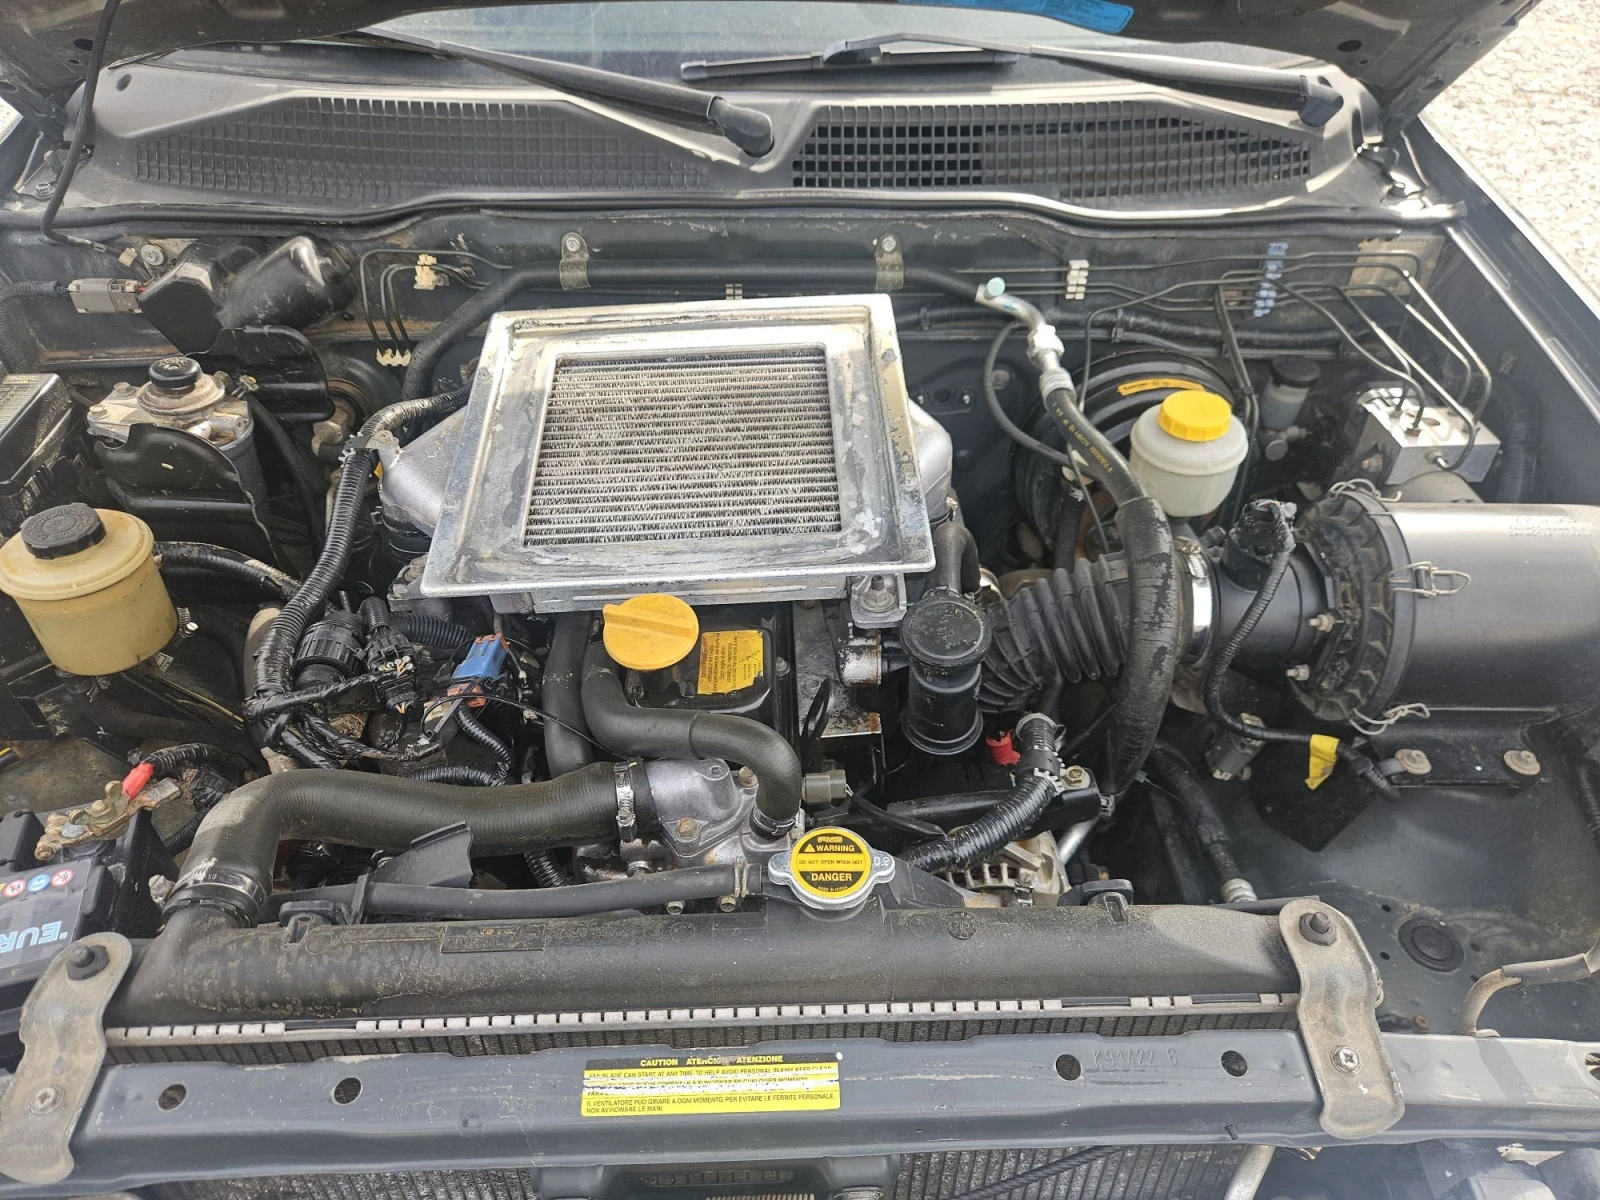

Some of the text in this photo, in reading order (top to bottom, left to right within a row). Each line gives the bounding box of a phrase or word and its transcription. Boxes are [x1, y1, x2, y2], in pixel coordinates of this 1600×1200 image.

[816, 844, 855, 852] WARNING
[873, 856, 890, 866] 0.9
[811, 873, 852, 881] DANGER
[640, 1058, 679, 1067] CAUTION
[736, 1055, 783, 1064] ATENZIONE
[593, 1099, 633, 1107] VENTILATORE
[738, 1095, 763, 1103] EVITARE
[600, 1106, 637, 1114] AVVICINARE
